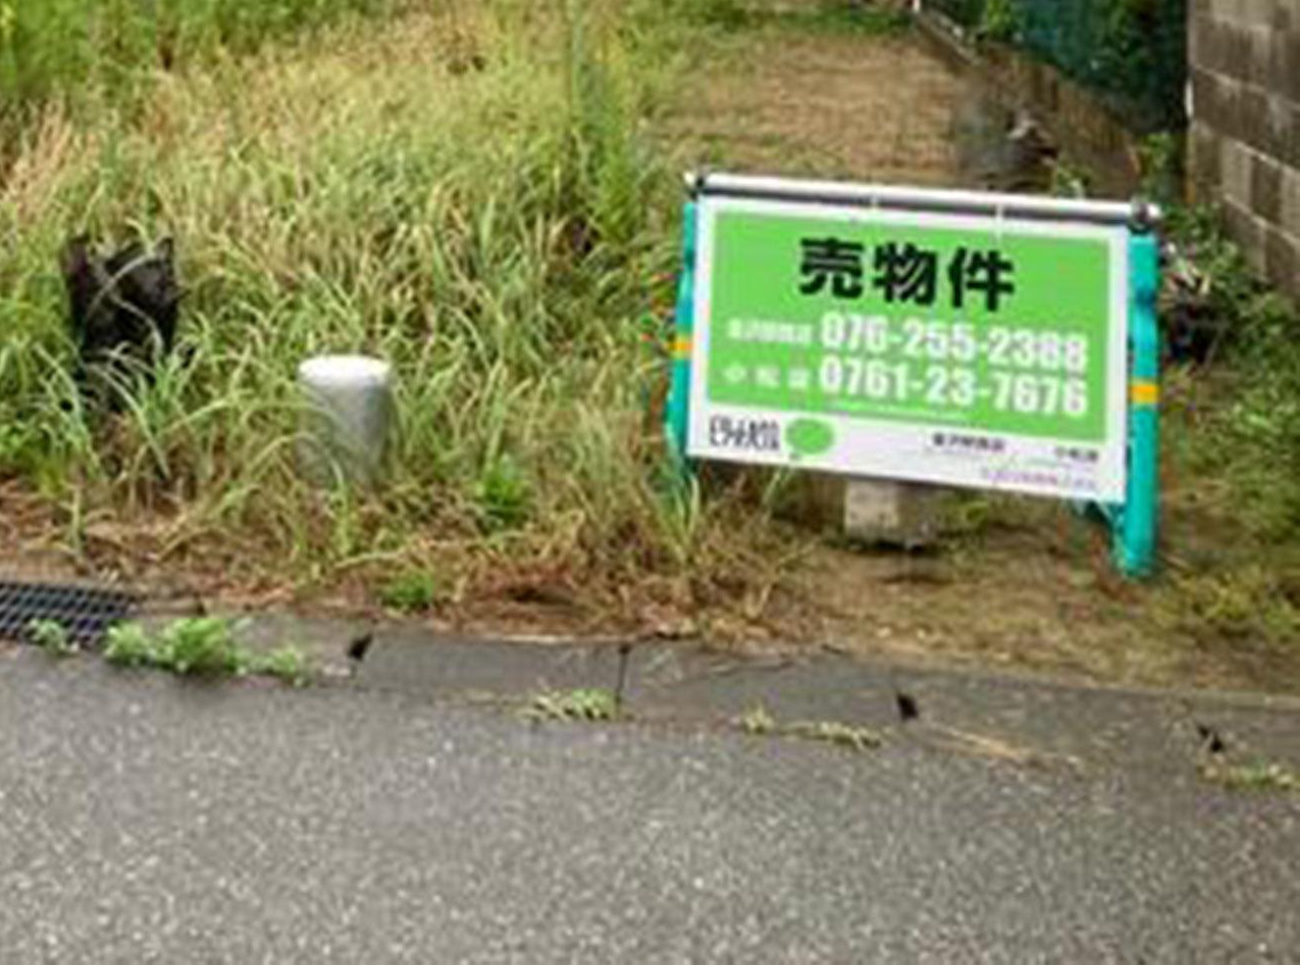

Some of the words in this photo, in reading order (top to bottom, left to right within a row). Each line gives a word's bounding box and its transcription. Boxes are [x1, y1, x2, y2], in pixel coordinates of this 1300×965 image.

[799, 238, 1015, 311] 売物件
[819, 355, 1089, 416] 0761-23-7676
